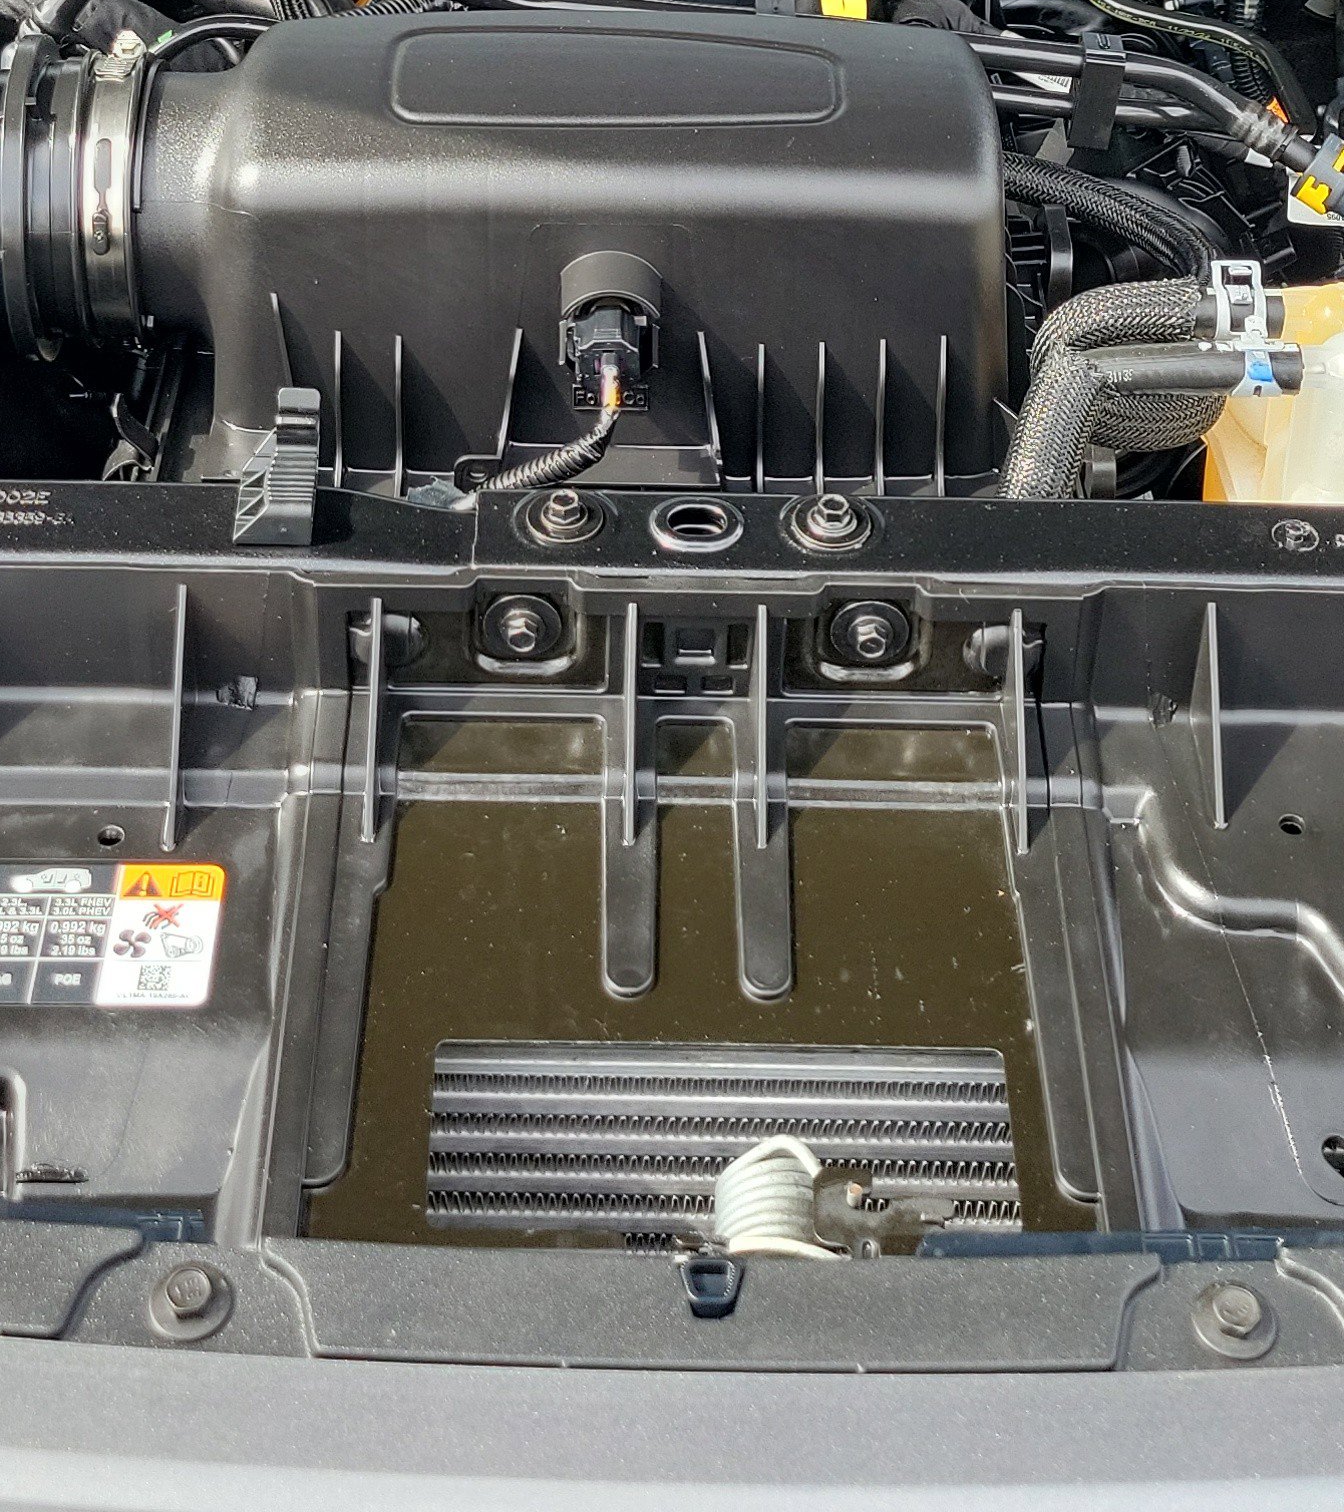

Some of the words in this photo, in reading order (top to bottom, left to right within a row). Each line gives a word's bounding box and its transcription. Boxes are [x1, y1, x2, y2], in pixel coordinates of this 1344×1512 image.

[22, 920, 40, 935] kg
[50, 921, 86, 934] 0.992
[88, 921, 106, 936] kg
[9, 935, 24, 944] oz
[60, 934, 75, 944] 35
[76, 936, 91, 945] oz
[10, 944, 29, 955] lbs
[77, 945, 96, 956] lbs
[54, 973, 81, 985] POE
